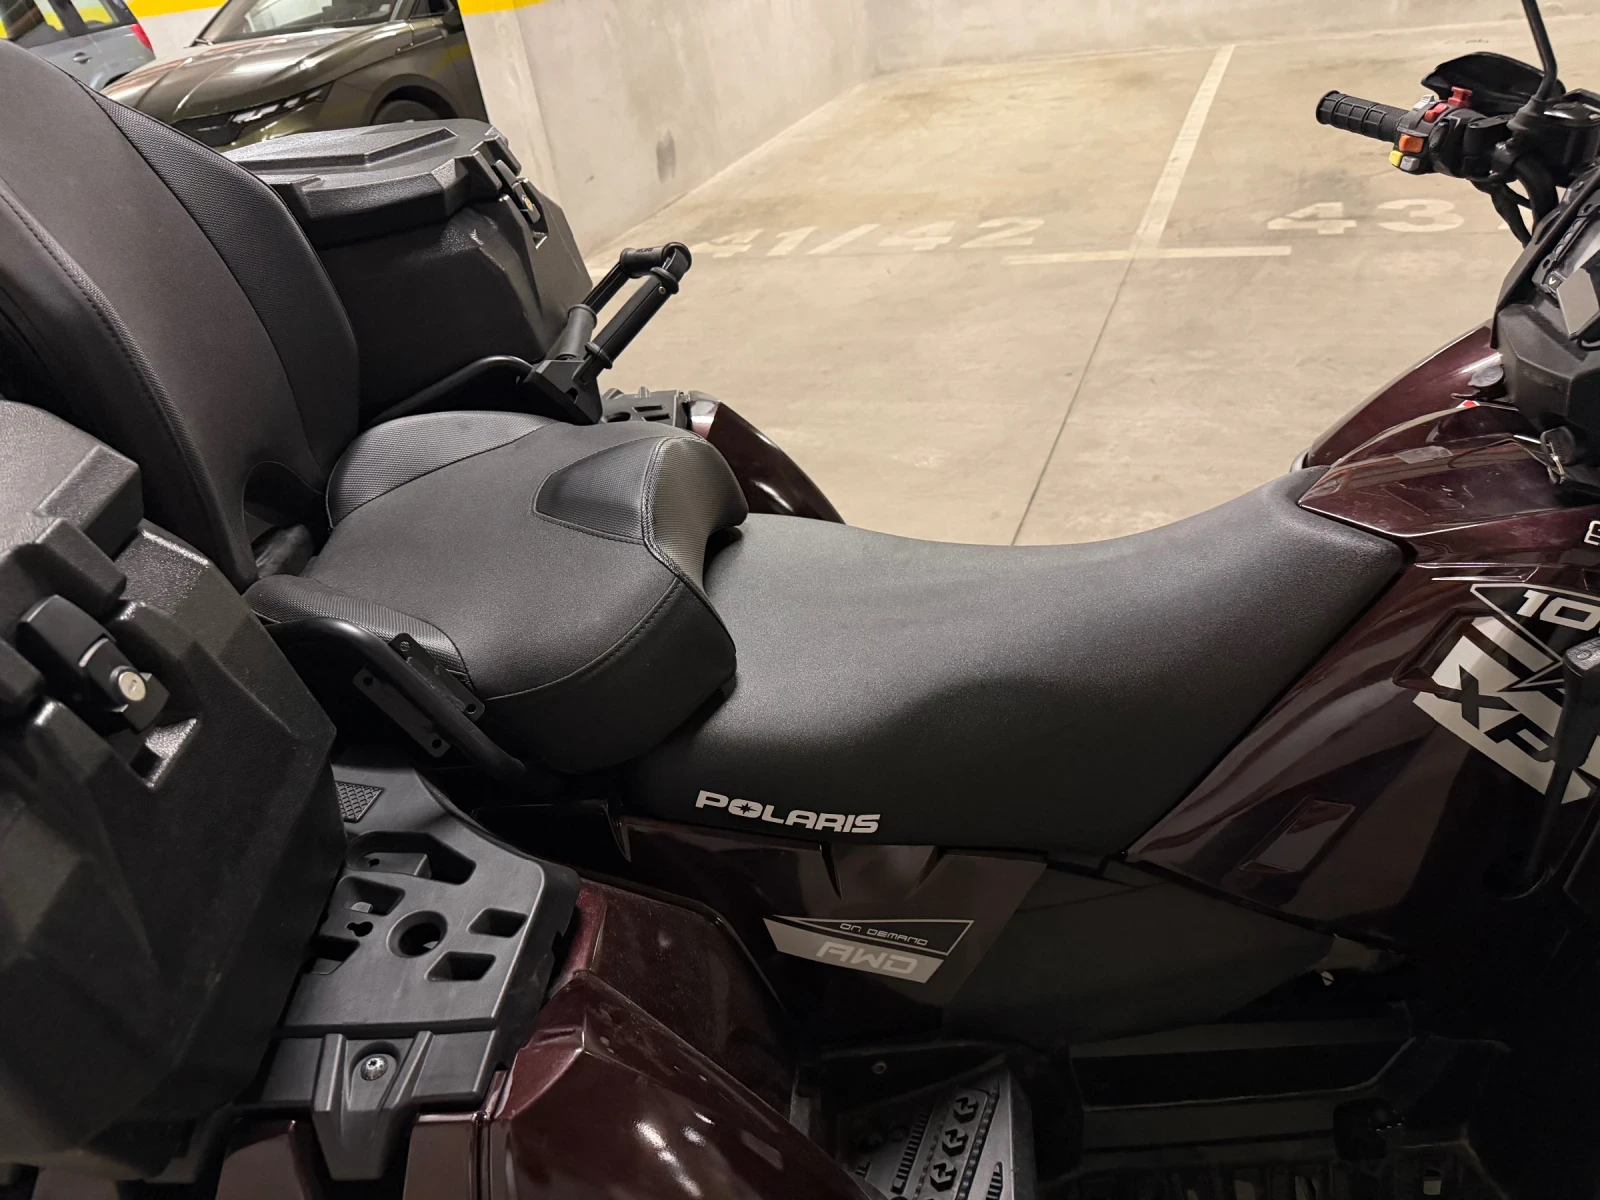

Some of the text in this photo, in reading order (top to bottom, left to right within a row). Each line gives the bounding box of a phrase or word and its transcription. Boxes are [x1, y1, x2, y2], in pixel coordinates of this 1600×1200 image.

[1267, 198, 1510, 235] 43
[689, 216, 1045, 258] 41/42
[1516, 589, 1600, 635] 10
[695, 790, 881, 834] POLARIS
[866, 928, 928, 946] DEMAND
[816, 941, 918, 974] AWD
